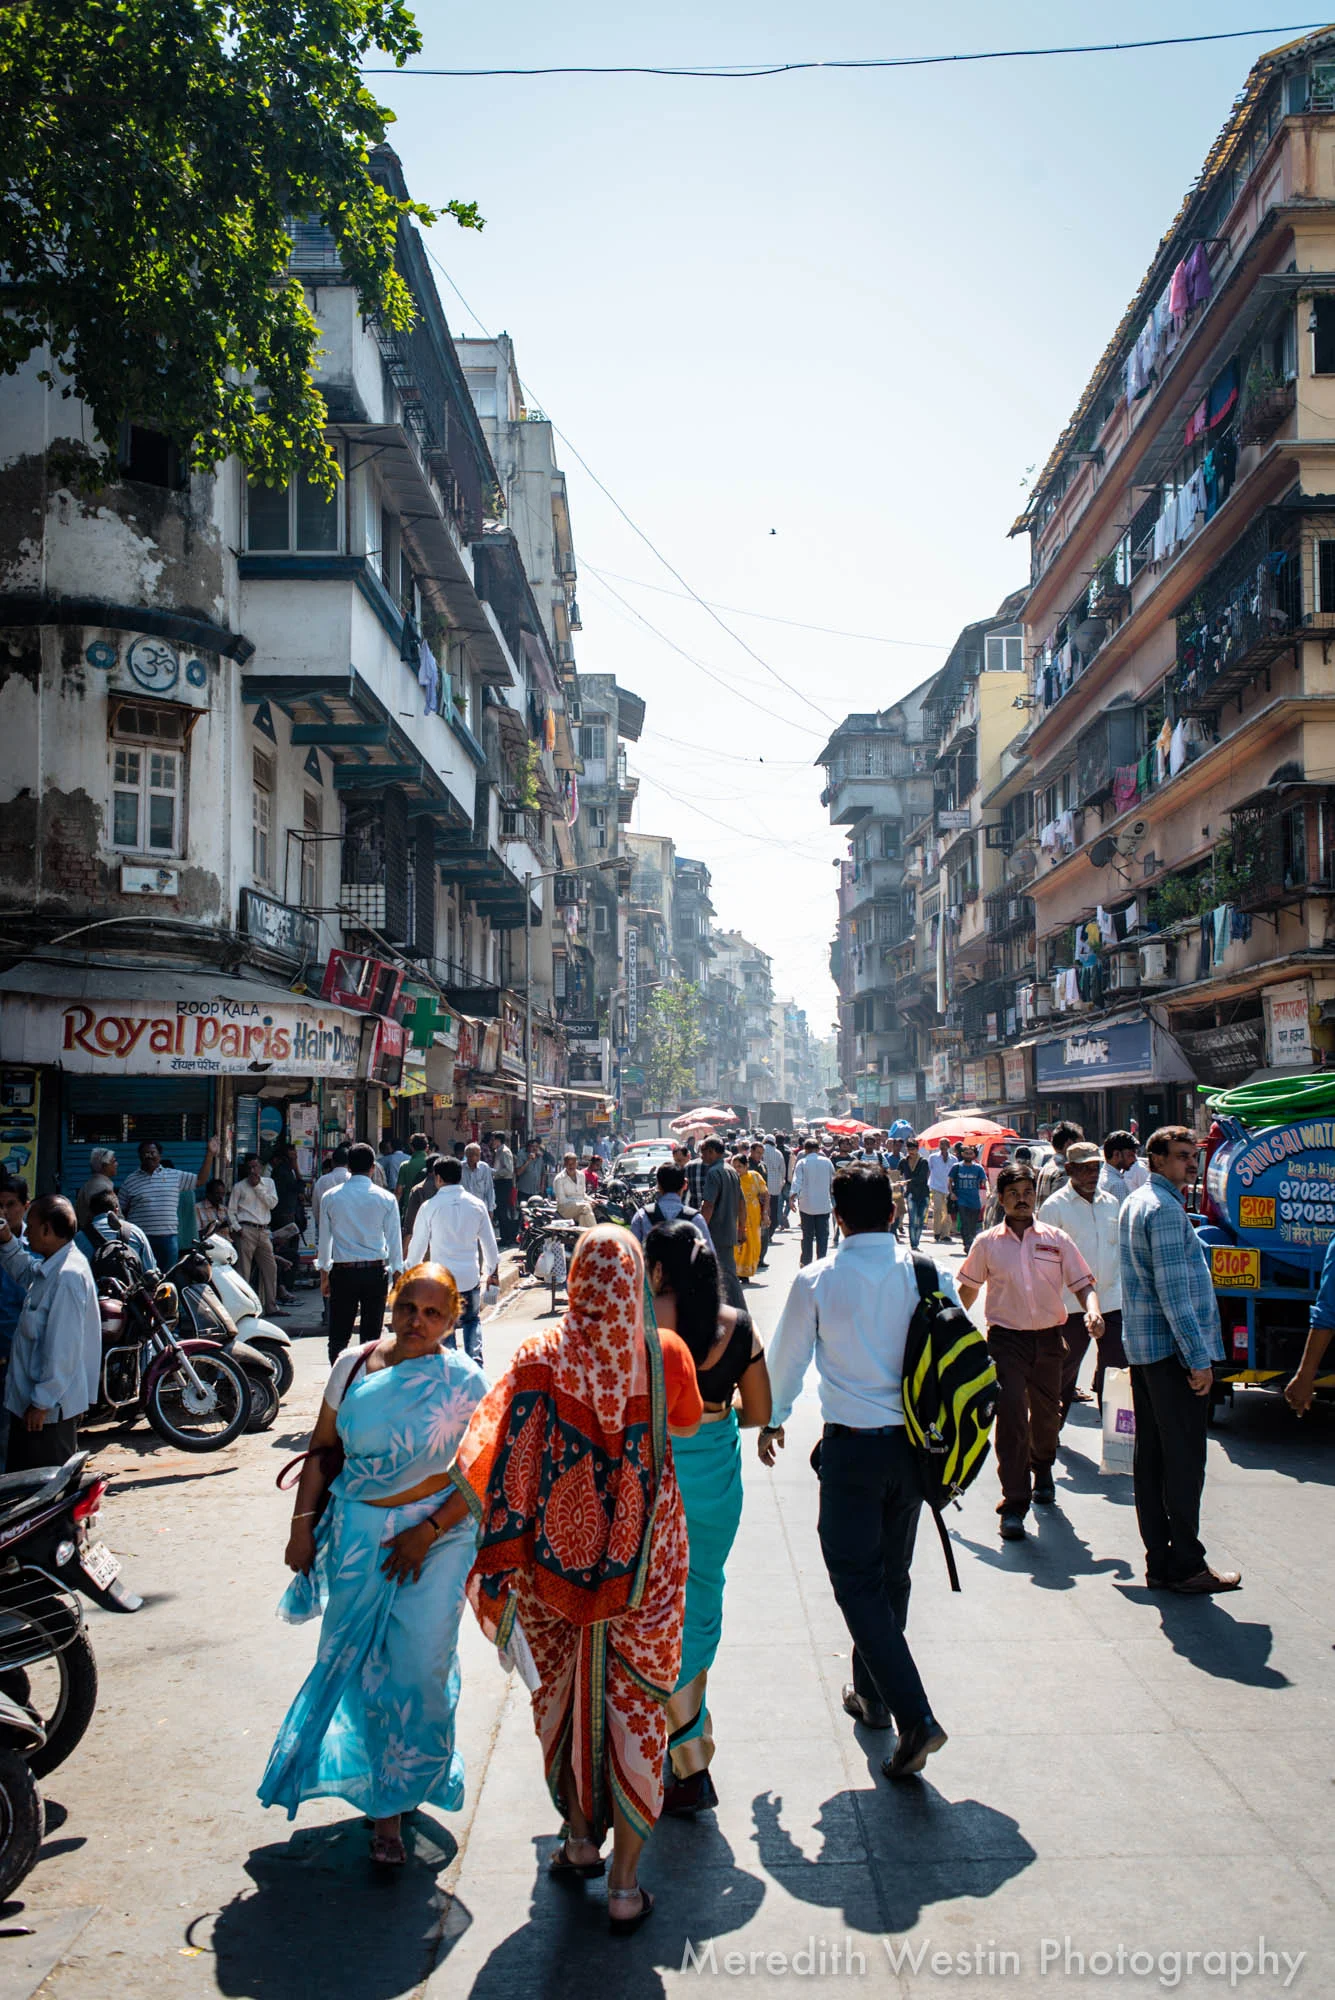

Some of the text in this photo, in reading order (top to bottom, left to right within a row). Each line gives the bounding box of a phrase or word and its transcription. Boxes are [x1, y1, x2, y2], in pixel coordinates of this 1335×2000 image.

[177, 1001, 259, 1018] ROOP KALA
[62, 1005, 185, 1058] Royal
[293, 1019, 333, 1060] Hair
[1236, 1141, 1275, 1186] SHIV
[1270, 1129, 1303, 1161] SAI
[1299, 1122, 1335, 1149] WAT
[1288, 1161, 1307, 1178] Day
[1241, 1198, 1275, 1217] STOP
[1214, 1250, 1251, 1274] STOP
